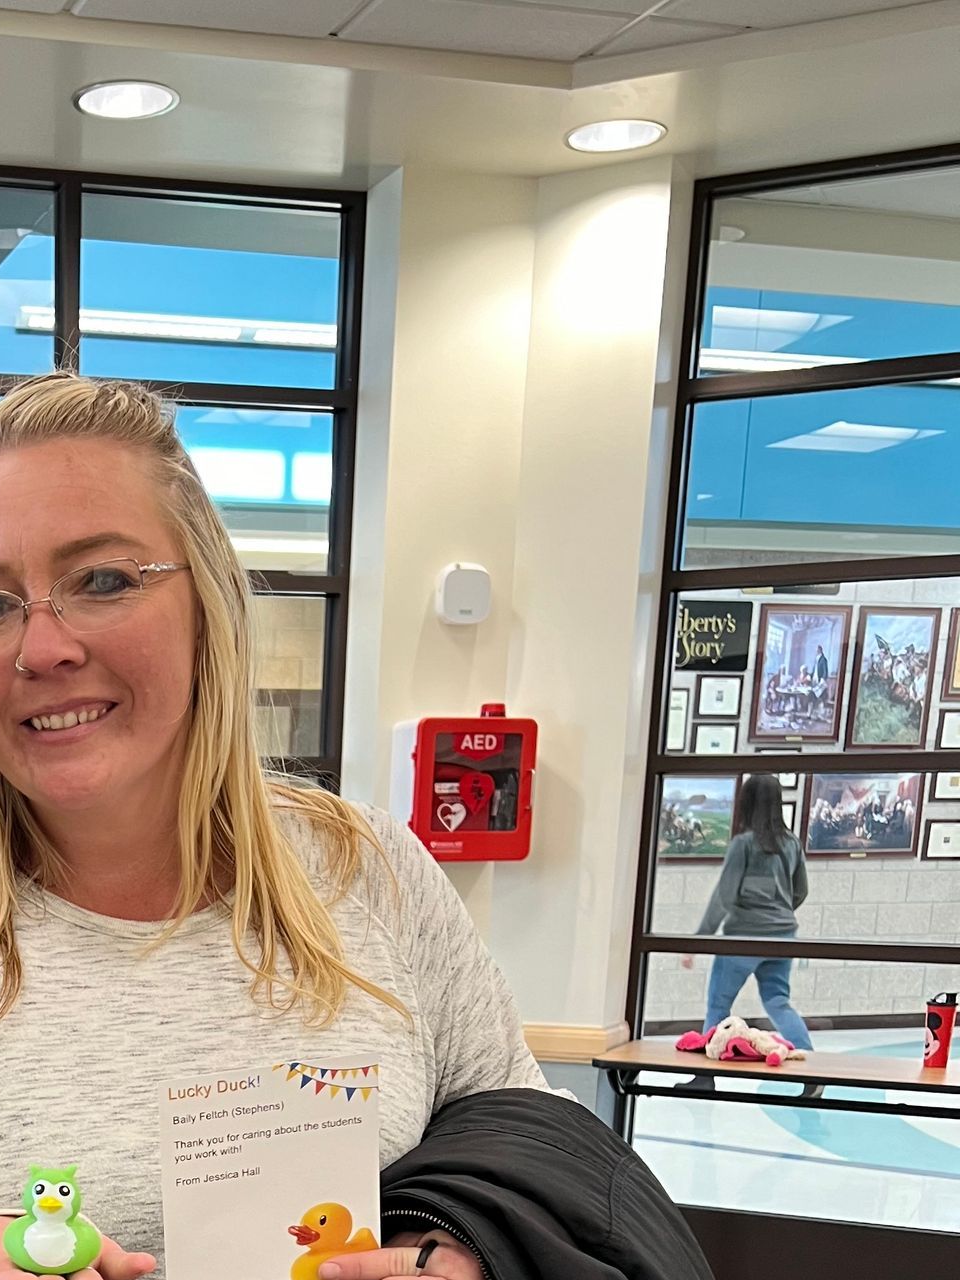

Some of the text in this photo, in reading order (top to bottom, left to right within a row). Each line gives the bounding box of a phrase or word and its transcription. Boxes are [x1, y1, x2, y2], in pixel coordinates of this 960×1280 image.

[677, 603, 737, 639] iberty's
[460, 734, 497, 750] AED
[168, 1075, 261, 1101] Lucky Duck!
[231, 1101, 285, 1118] (Stephens)
[174, 1116, 363, 1149] Thank you for caring about the students
[174, 1145, 243, 1164] you work with!
[175, 1166, 261, 1187] From Jessica Hall
